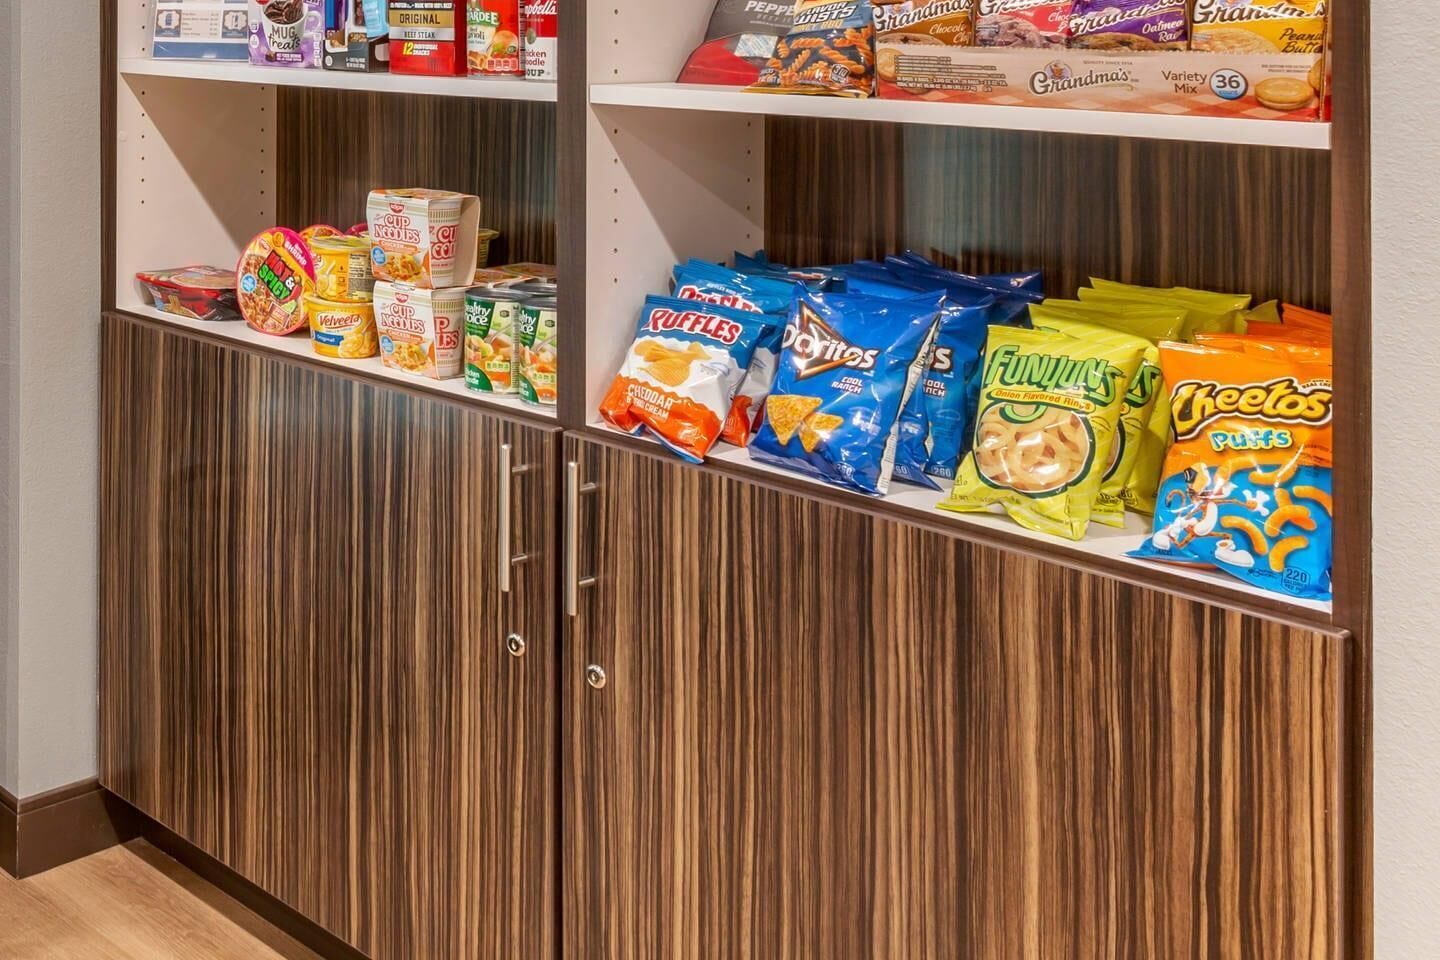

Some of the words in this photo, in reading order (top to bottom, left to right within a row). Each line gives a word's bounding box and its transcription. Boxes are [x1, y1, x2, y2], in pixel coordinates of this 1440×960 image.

[467, 9, 498, 23] ARDEE
[526, 0, 558, 16] pbell's
[744, 0, 795, 17] PEPPE
[399, 13, 440, 24] ORIGINAL
[272, 25, 296, 39] MUG
[418, 30, 435, 38] STEAK
[1142, 20, 1184, 34] Oatmea
[1279, 27, 1322, 41] Peanu
[403, 42, 414, 55] 12
[1028, 67, 1131, 96] Grandma's
[1162, 69, 1208, 85] Variety
[1215, 73, 1241, 89] 36
[1174, 81, 1198, 95] Mix
[384, 214, 410, 228] CUP
[374, 224, 420, 244] NOODLES
[284, 240, 308, 266] SHRIMP
[264, 250, 295, 281] HOT
[285, 276, 295, 290] &
[259, 263, 291, 300] SPICY
[390, 303, 415, 318] CUP
[319, 313, 360, 327] Velveeta
[381, 313, 425, 334] NOODLES
[645, 307, 743, 344] RUFFLES
[782, 325, 879, 370] Doritos
[841, 376, 863, 386] COOL
[984, 345, 1124, 405] FUNYUNS
[831, 381, 862, 394] RANCH
[924, 379, 945, 389] OOL
[627, 384, 673, 410] CHEDDAR
[995, 389, 1021, 399] Onion
[1023, 391, 1062, 404] Flavored
[1064, 397, 1092, 410] Rings
[645, 402, 669, 420] CREAM
[1172, 378, 1332, 435] Cheetos
[1211, 428, 1293, 452] Puffs
[933, 467, 951, 477] 260
[1286, 568, 1307, 583] 220
